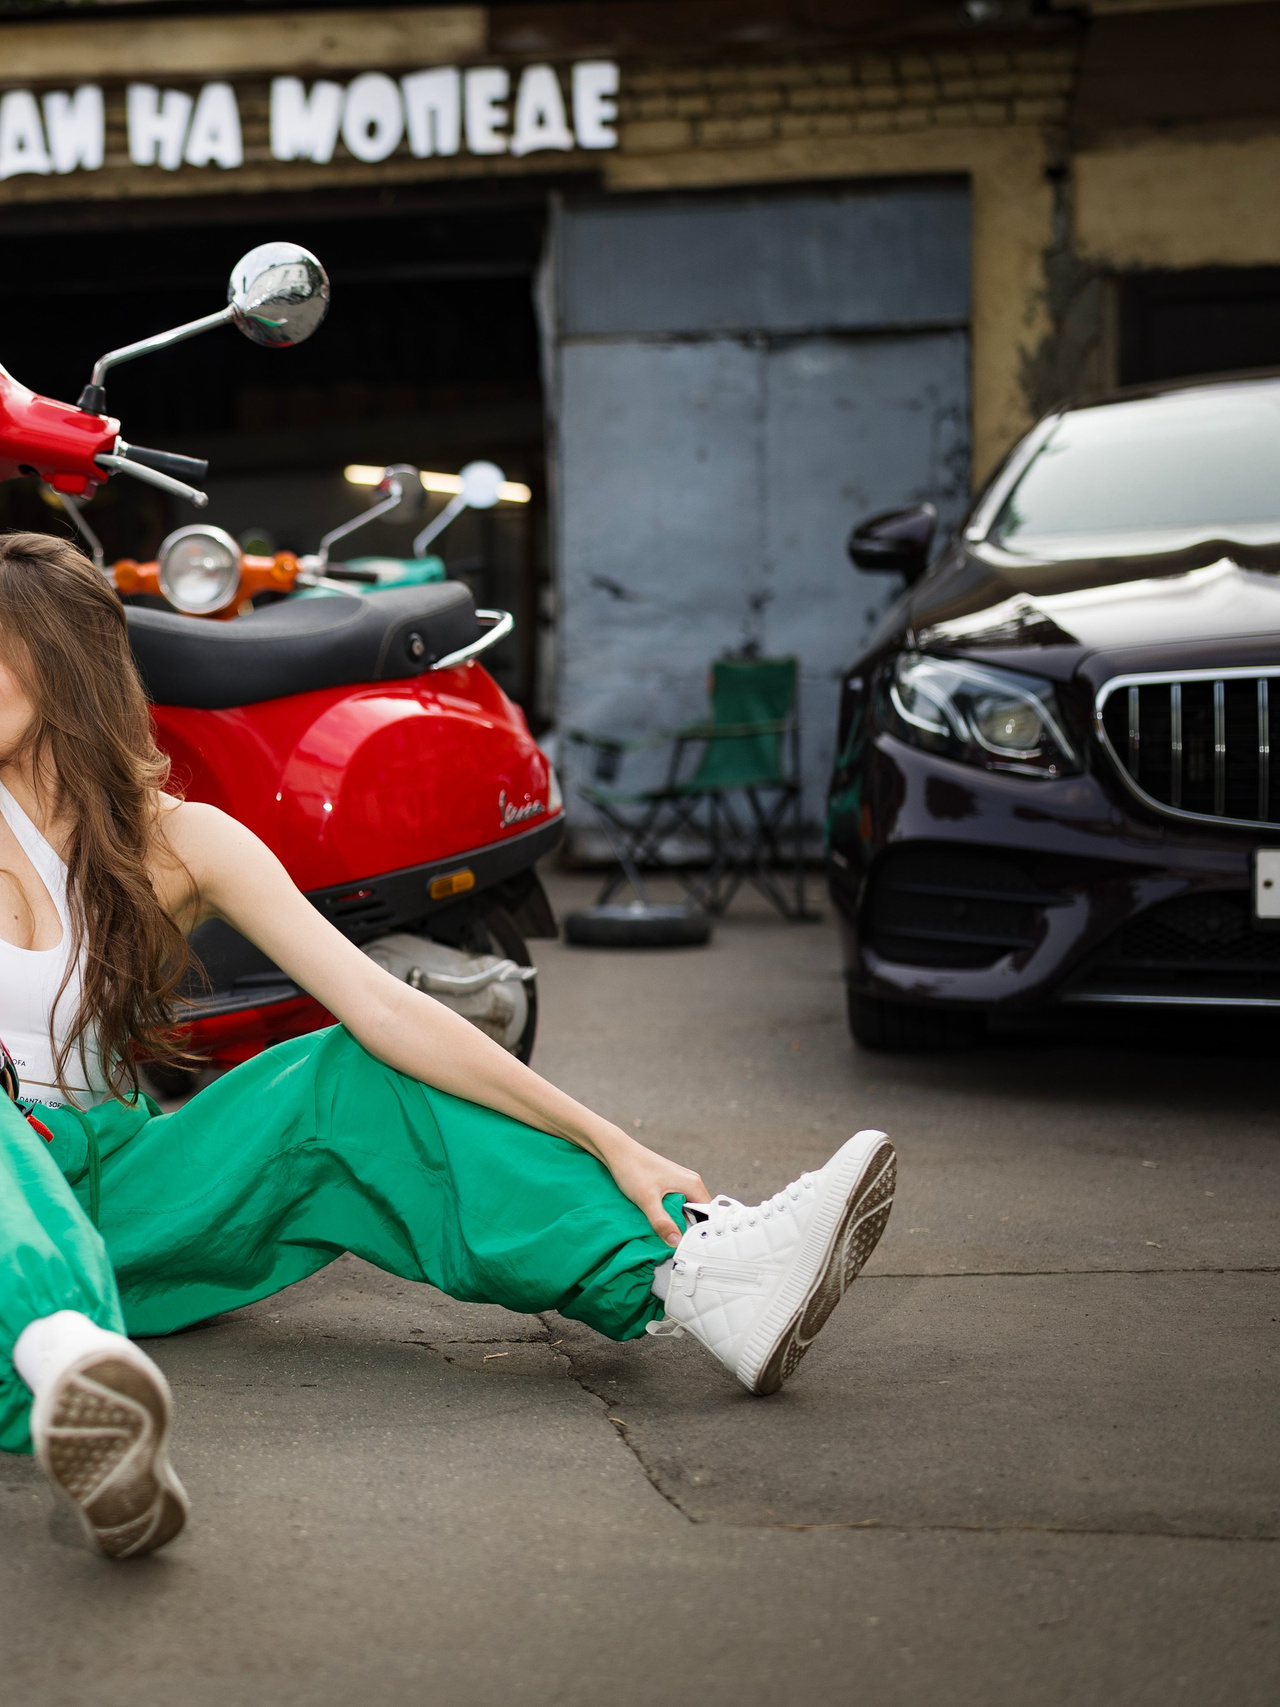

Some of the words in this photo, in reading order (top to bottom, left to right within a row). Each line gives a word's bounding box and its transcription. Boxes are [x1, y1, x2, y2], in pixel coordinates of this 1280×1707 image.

[127, 84, 244, 169] НА
[270, 62, 620, 164] МОПЕДЕ
[12, 1058, 26, 1067] OFA
